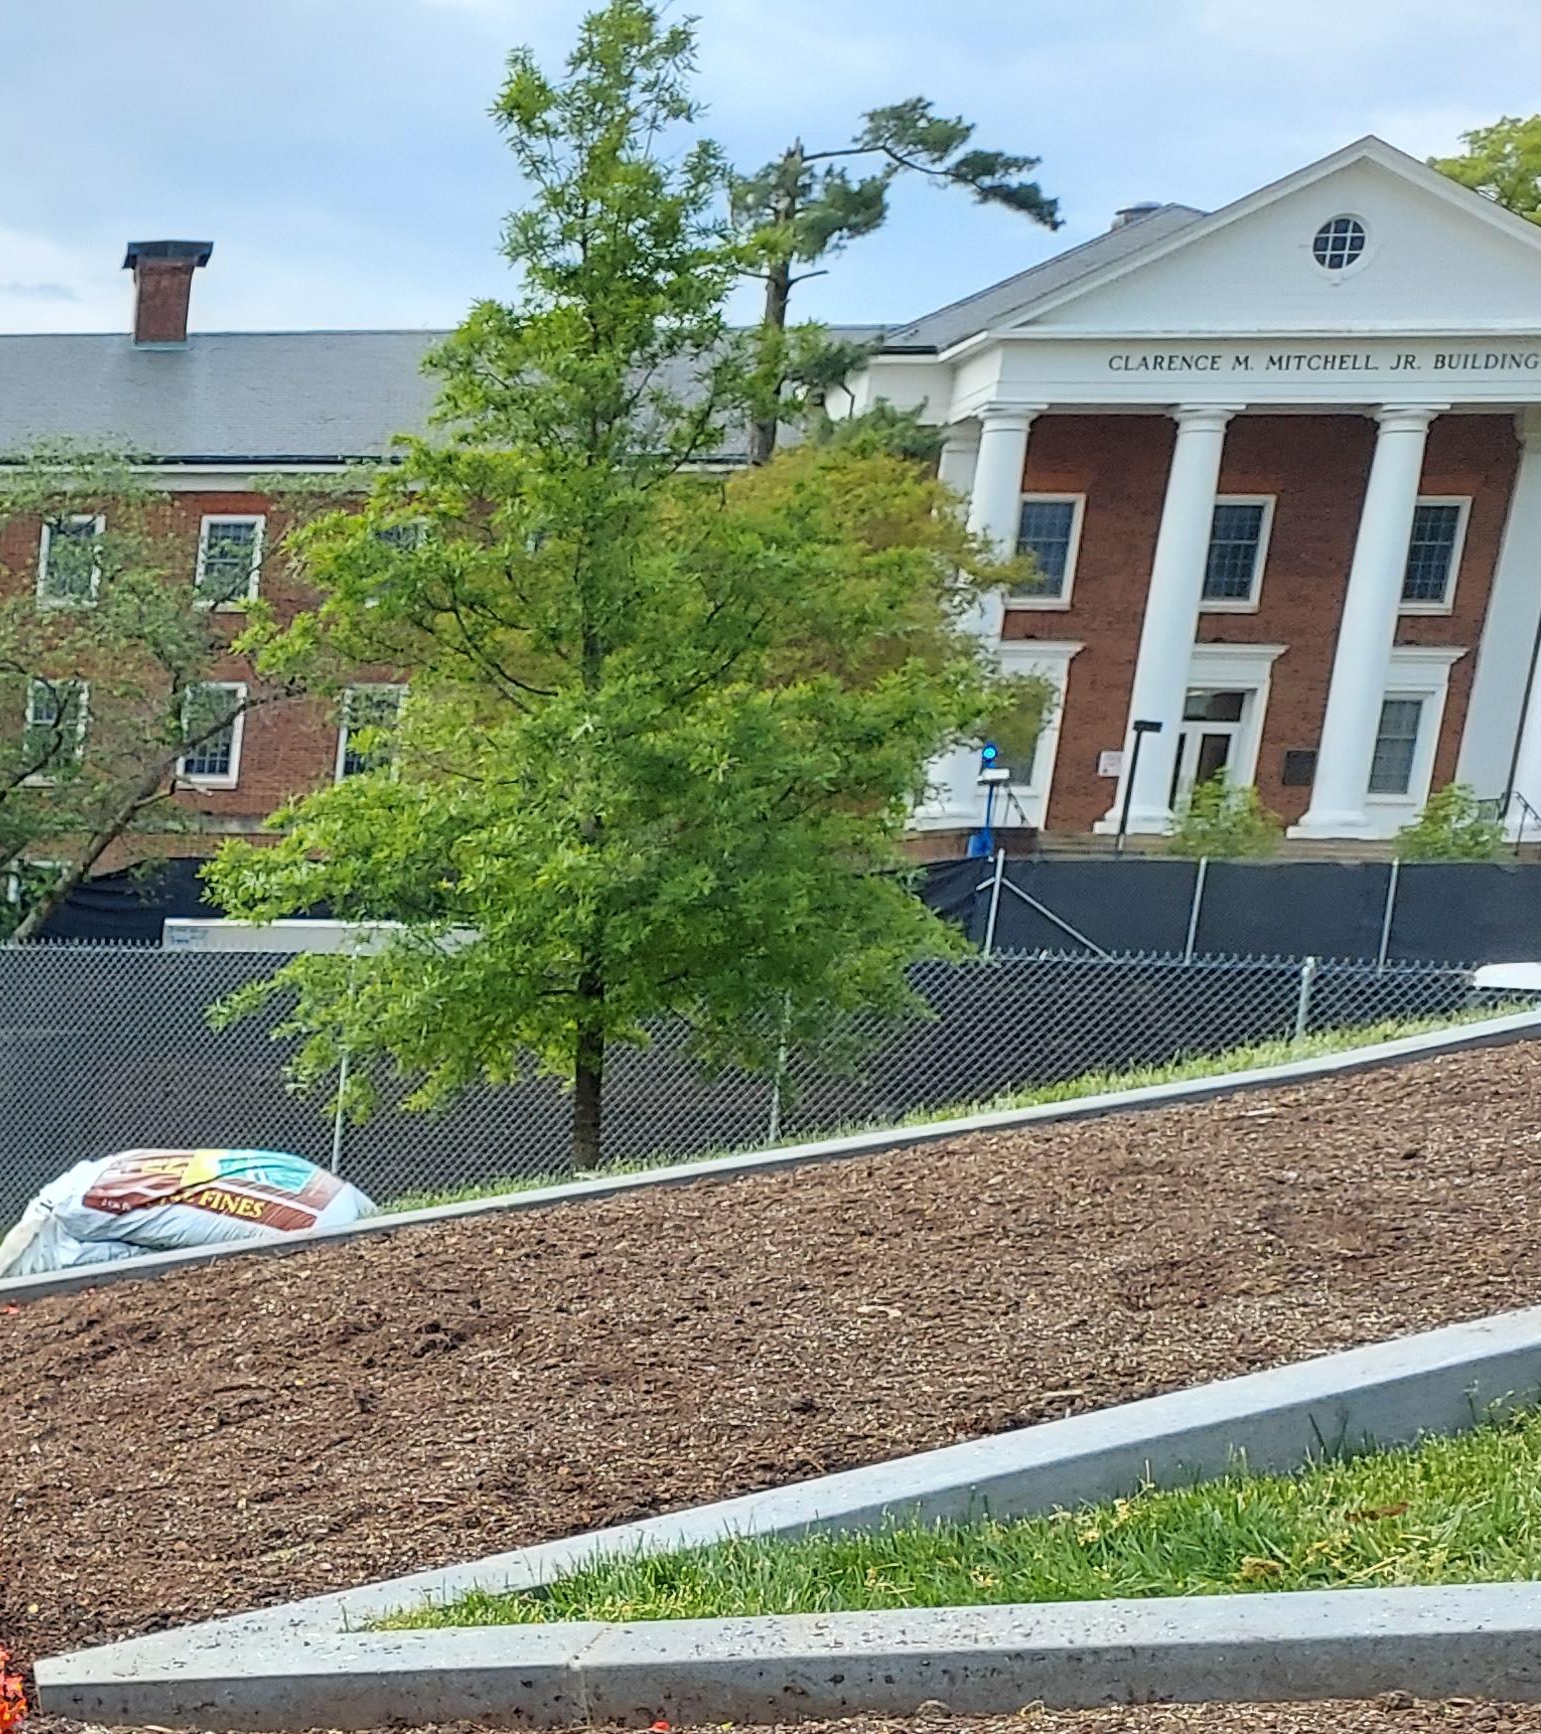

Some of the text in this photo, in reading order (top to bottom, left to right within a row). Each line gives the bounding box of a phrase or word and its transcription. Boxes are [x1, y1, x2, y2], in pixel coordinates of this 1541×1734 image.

[1108, 354, 1223, 371] CLARENCE
[1231, 354, 1254, 371] M.
[1389, 353, 1422, 371] JR.
[1432, 352, 1541, 370] BUILDING
[197, 1189, 267, 1219] FINES
